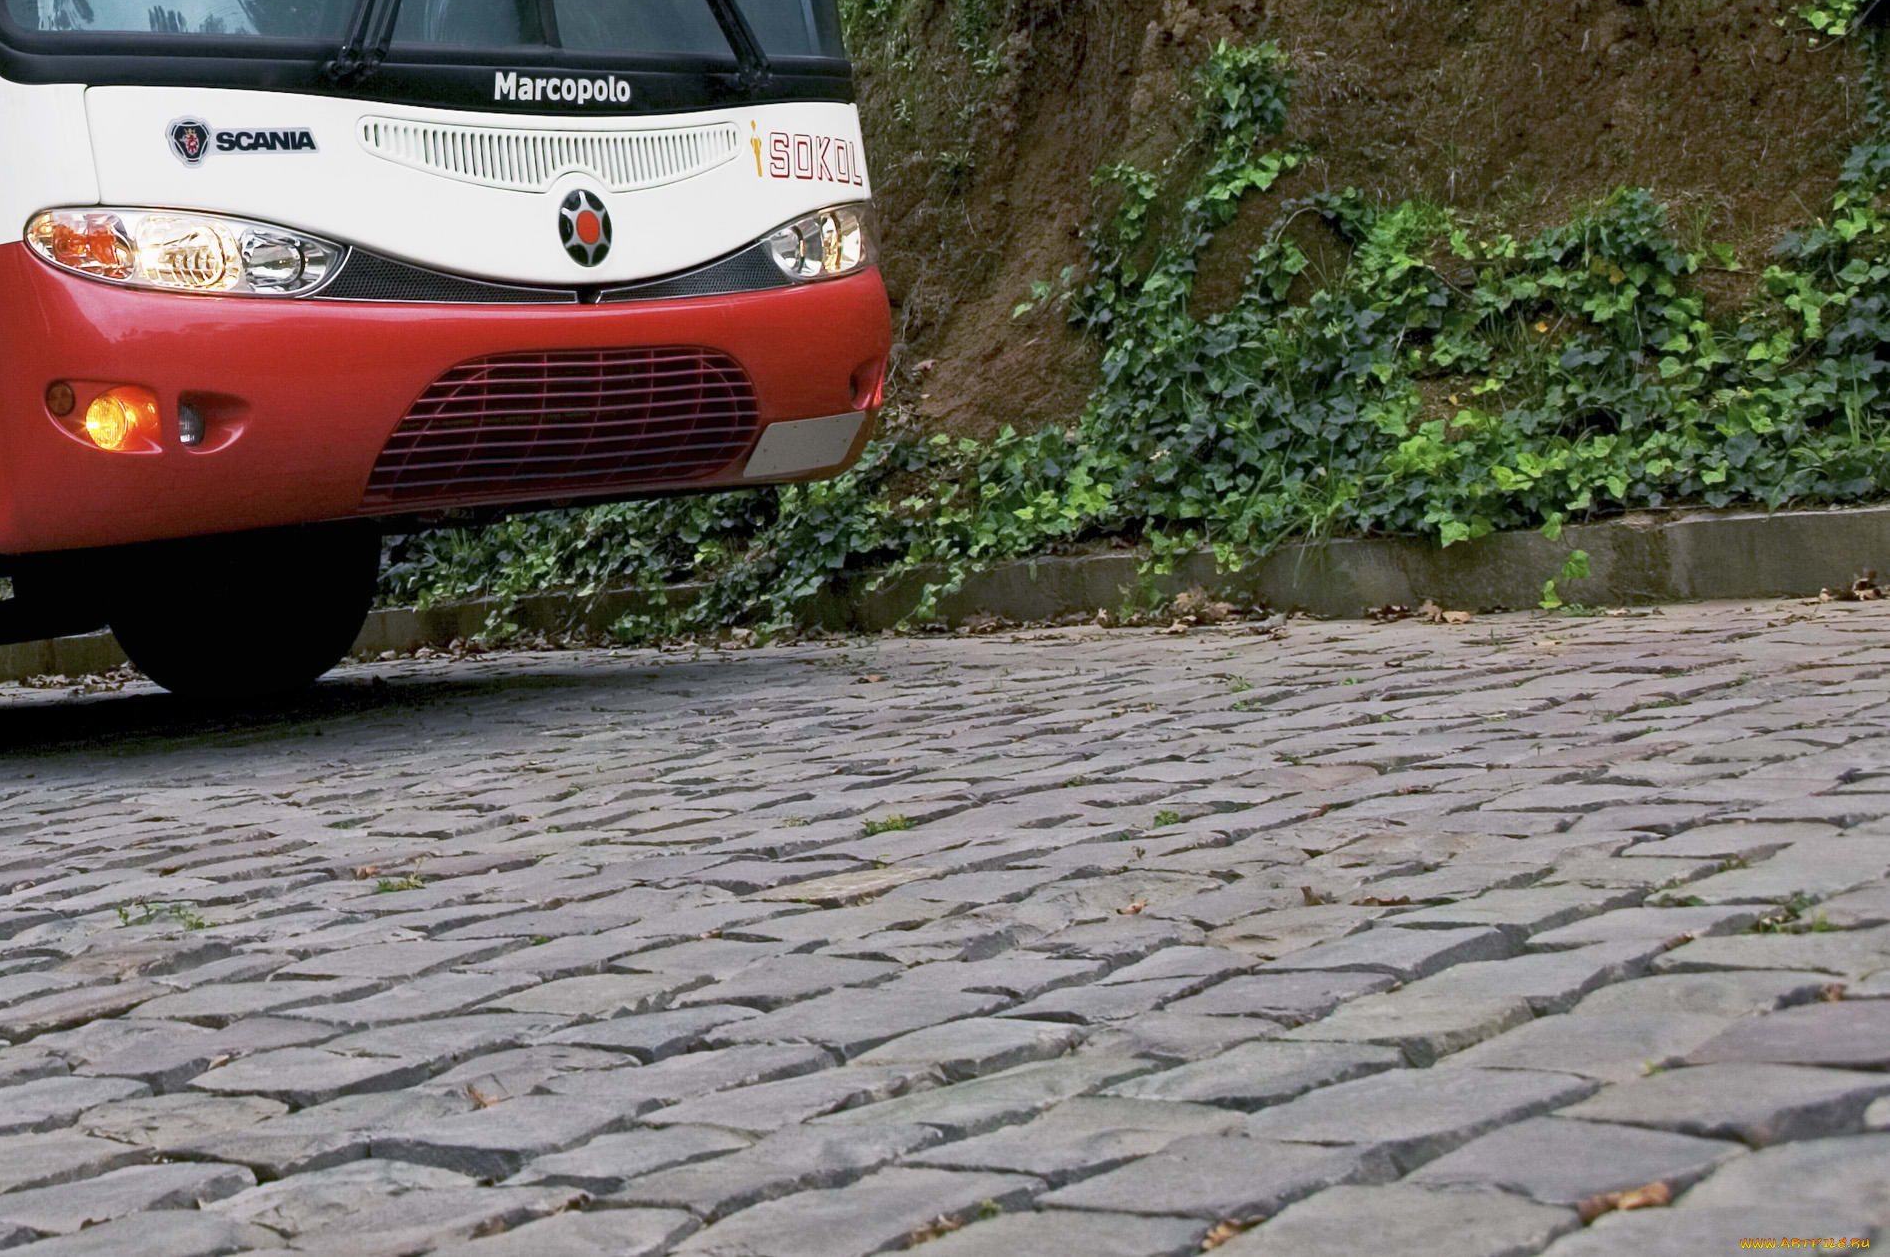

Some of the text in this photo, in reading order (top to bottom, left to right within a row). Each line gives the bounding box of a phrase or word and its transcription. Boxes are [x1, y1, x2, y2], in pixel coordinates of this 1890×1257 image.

[494, 71, 631, 105] Marcopolo
[216, 131, 316, 152] SCANIA
[770, 132, 863, 187] SOKOL
